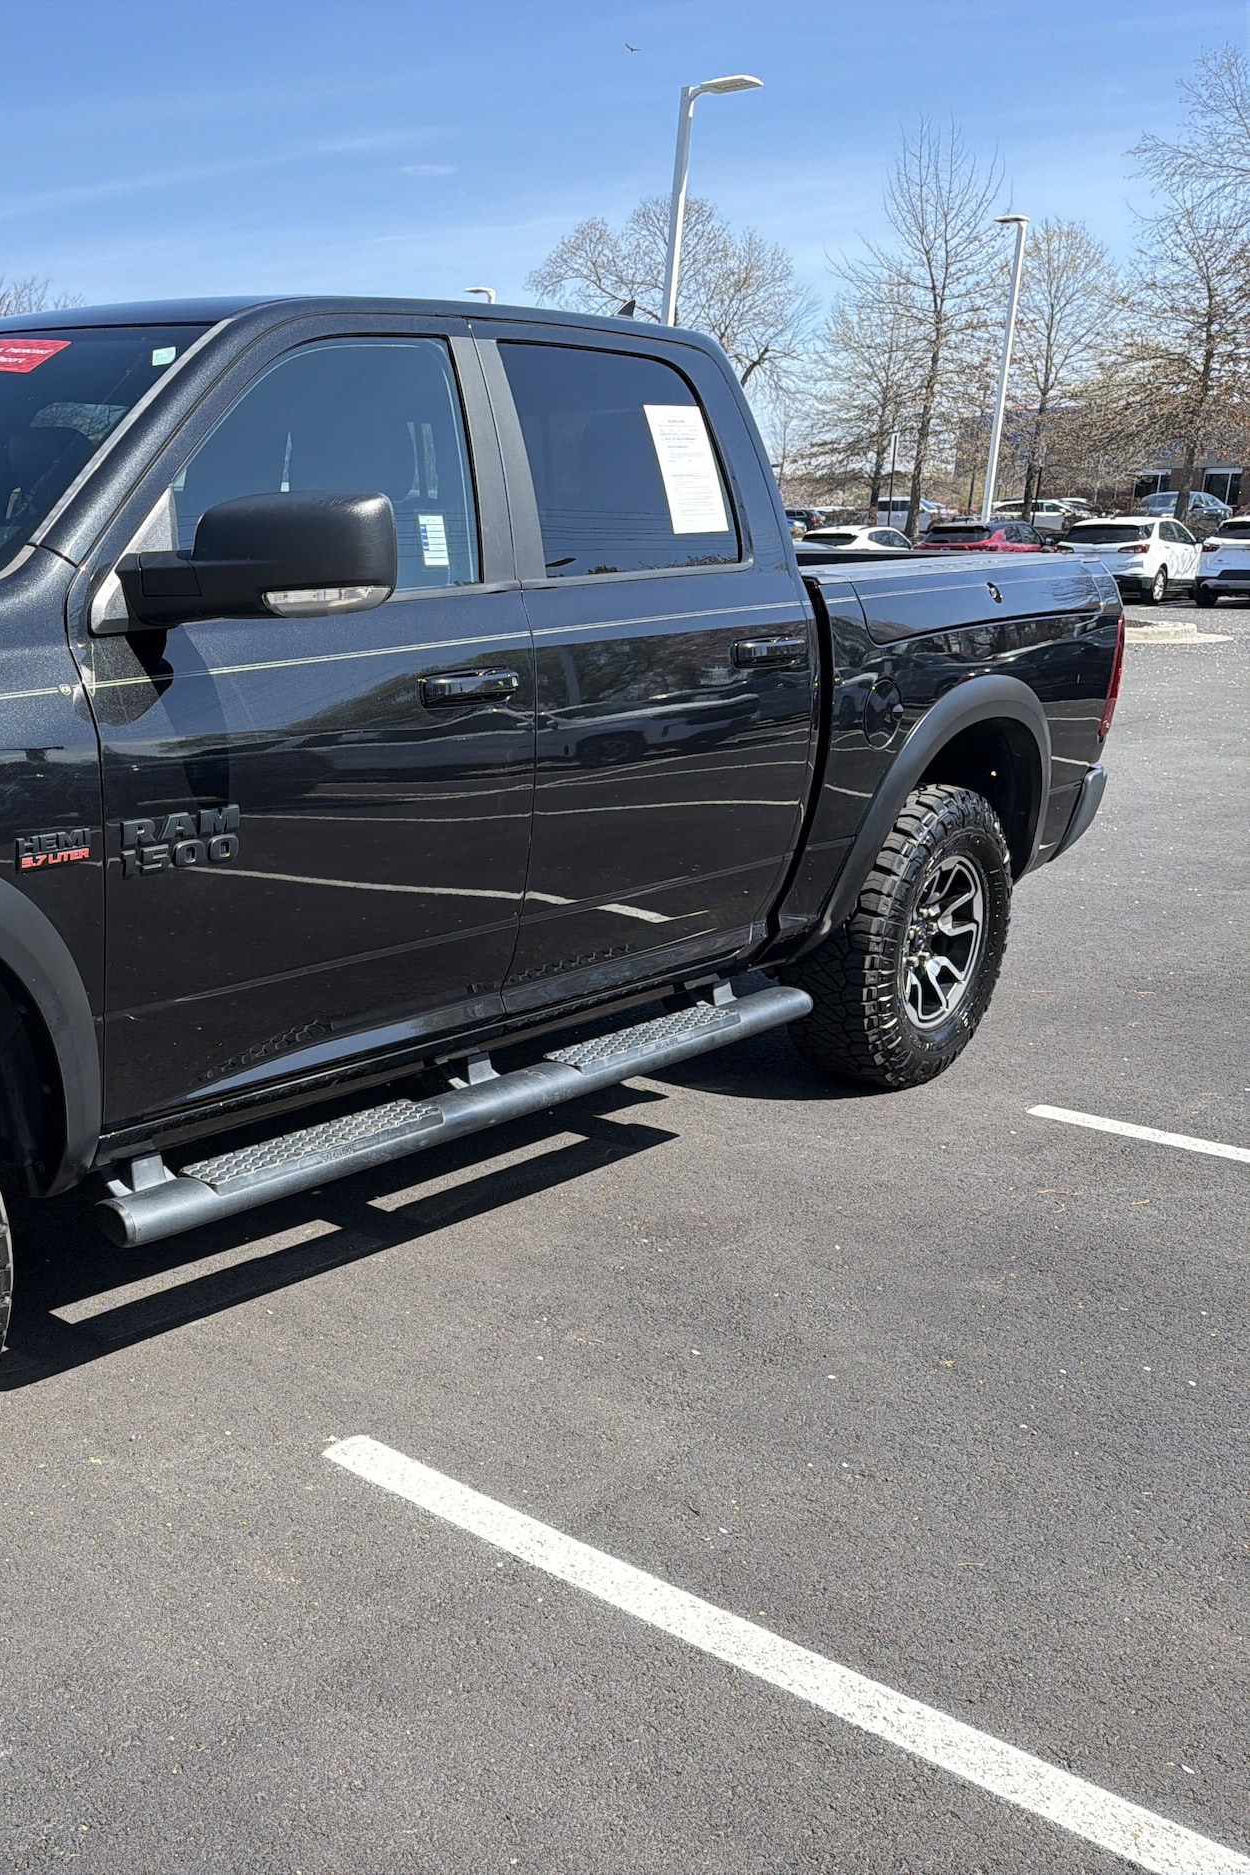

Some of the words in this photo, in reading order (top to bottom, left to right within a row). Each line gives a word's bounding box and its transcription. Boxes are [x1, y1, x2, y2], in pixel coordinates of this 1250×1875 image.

[15, 828, 90, 857] HEMI
[121, 804, 240, 849] RAM
[21, 855, 48, 869] 5.7
[48, 847, 90, 864] LITER
[121, 832, 239, 879] 1500
